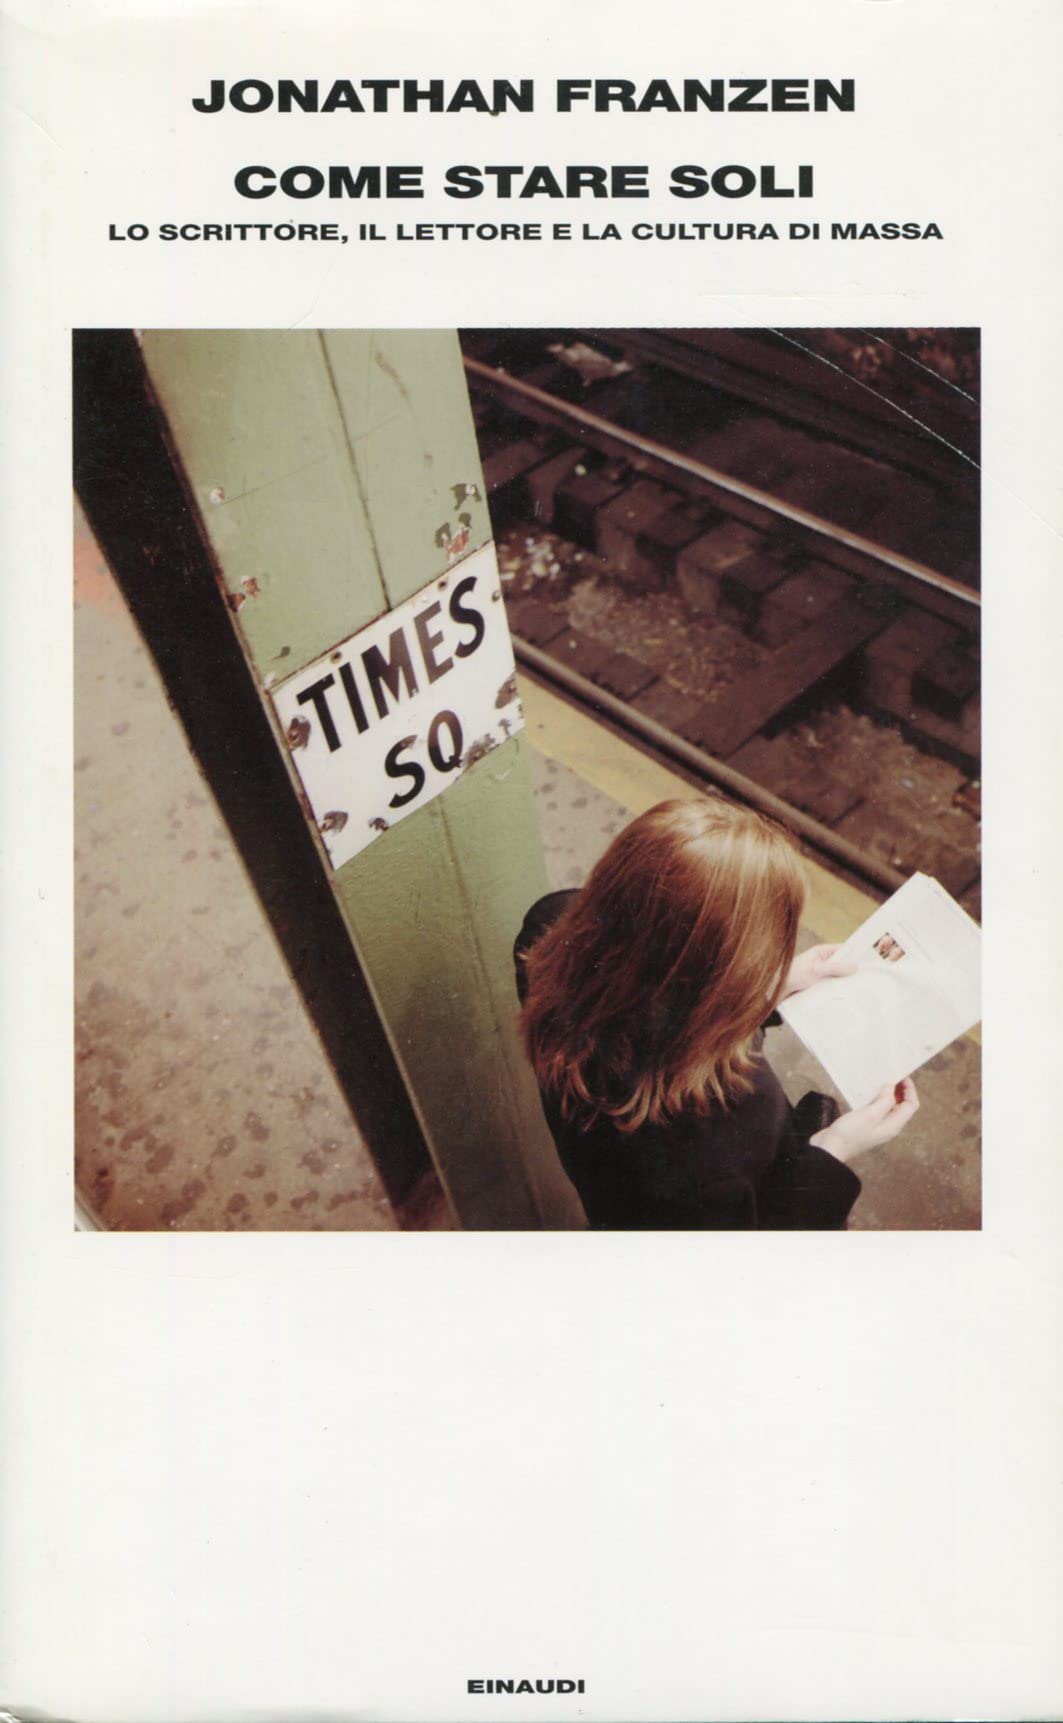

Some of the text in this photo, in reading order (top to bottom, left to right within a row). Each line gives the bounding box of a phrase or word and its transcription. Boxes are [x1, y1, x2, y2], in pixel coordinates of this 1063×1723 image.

[192, 79, 855, 113] JONATHAN FRANZEN
[234, 165, 813, 199] COME STARE SOLI
[109, 223, 943, 244] LO SCRITTORE, IL LETTORE E LA CULTURA DI MASSA
[296, 576, 485, 753] TIMES
[384, 709, 464, 809] SQ
[467, 1679, 585, 1694] EINAUDI
